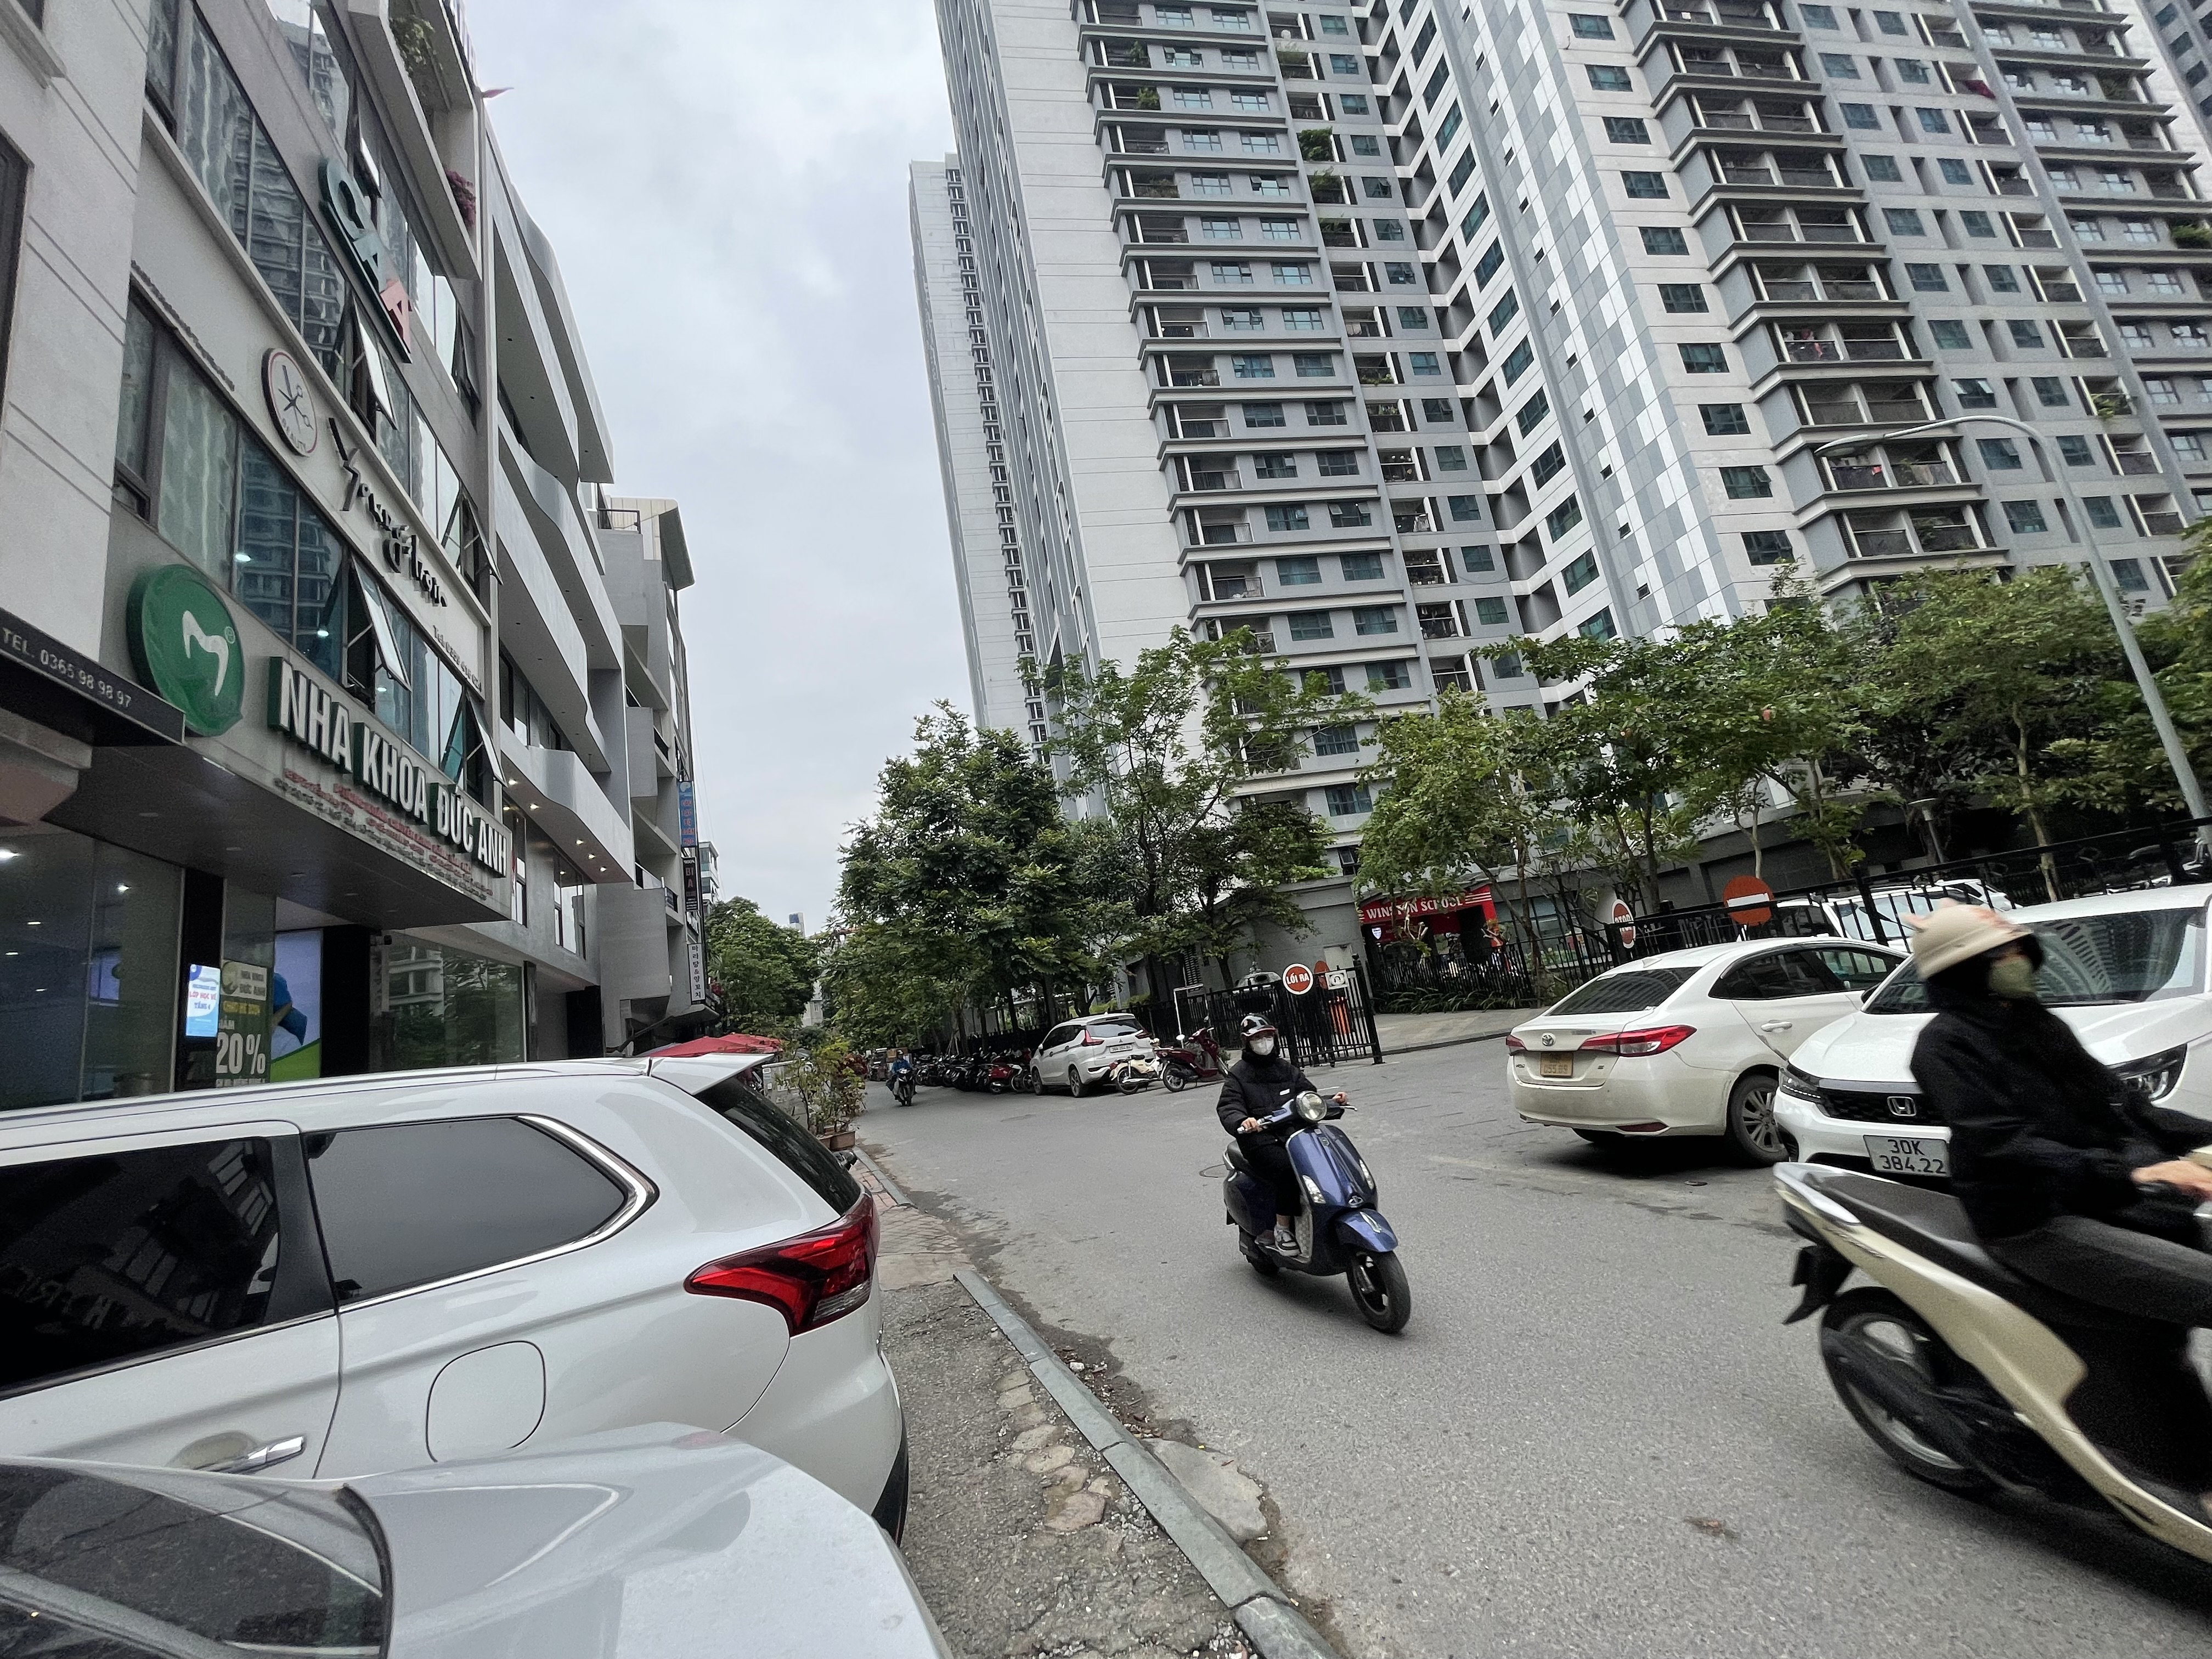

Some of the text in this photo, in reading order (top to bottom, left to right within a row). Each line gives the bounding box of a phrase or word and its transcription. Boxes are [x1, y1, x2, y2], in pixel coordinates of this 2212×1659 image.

[40, 649, 75, 679] 0365
[78, 670, 94, 690] 98
[98, 680, 113, 699] 98
[116, 690, 132, 708] 97
[279, 657, 353, 774] NHA
[362, 723, 430, 825] KHOA
[437, 783, 473, 854] ĐỨC
[477, 819, 507, 877] ANH
[1367, 902, 1418, 919] WINSN
[1286, 972, 1310, 985] LỐI RA
[216, 1032, 266, 1075] 20%
[1887, 1139, 1925, 1155] 30K
[1879, 1155, 1946, 1174] 384.22
